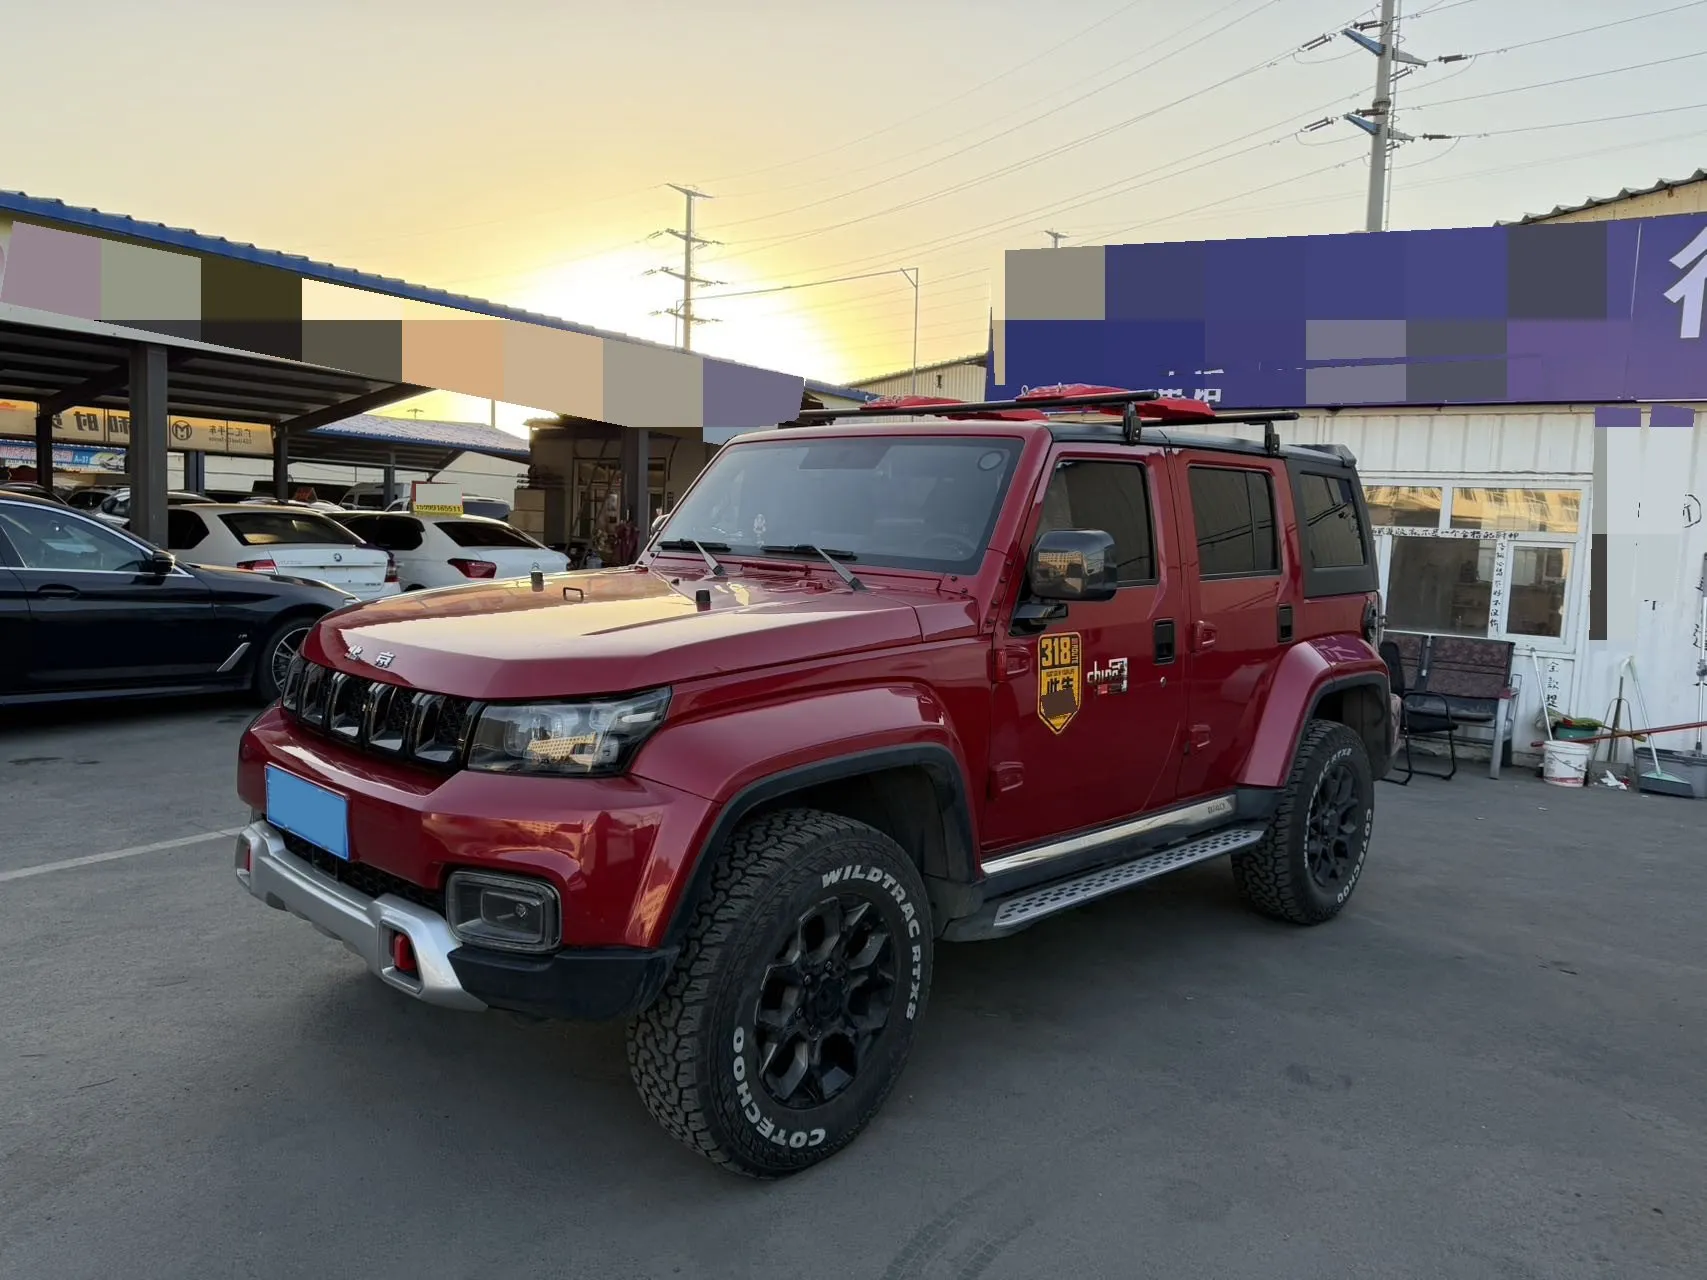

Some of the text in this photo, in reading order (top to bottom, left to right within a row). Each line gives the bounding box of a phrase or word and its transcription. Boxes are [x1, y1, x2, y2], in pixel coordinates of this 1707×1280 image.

[1041, 637, 1071, 667] 318
[821, 864, 921, 938] WILDTRAC
[732, 1026, 827, 1149] COTECHOO
